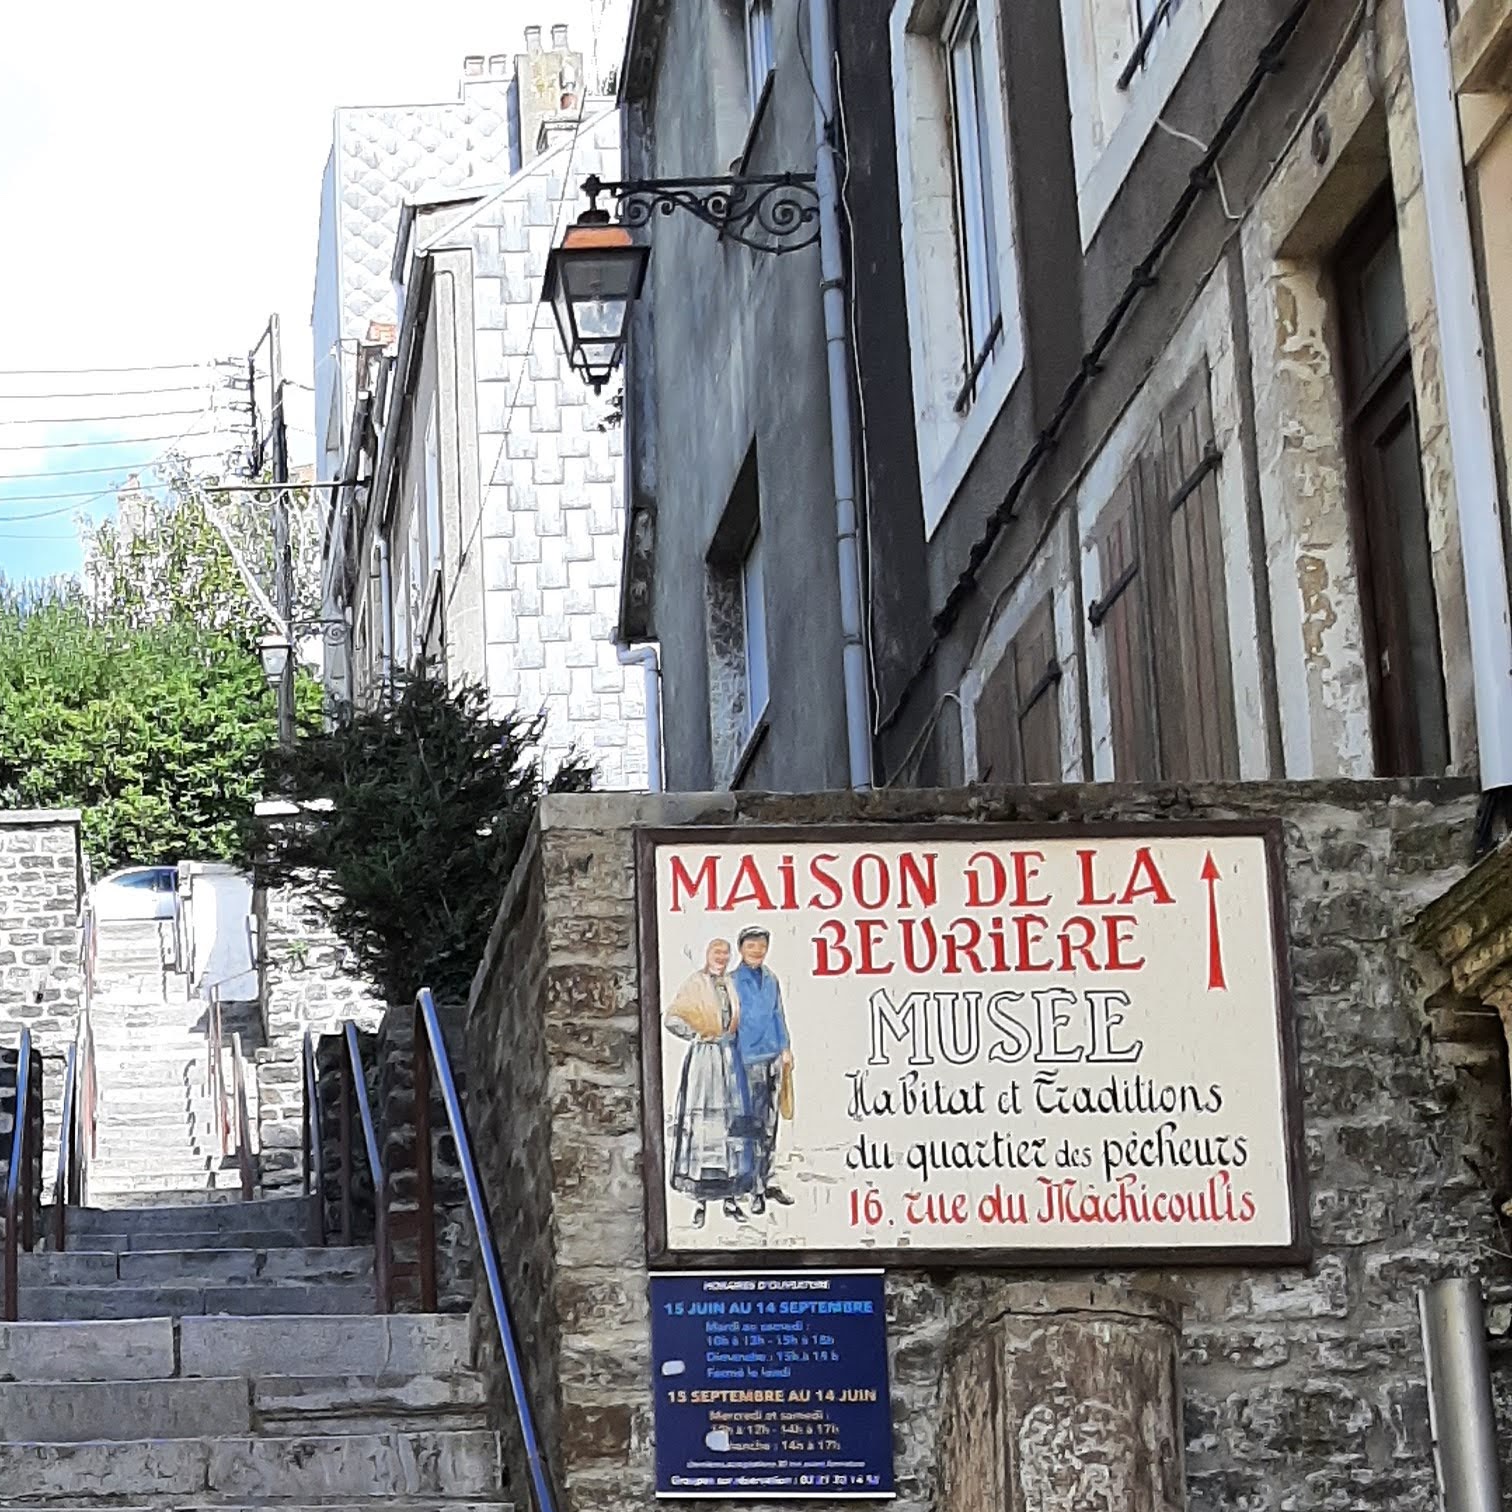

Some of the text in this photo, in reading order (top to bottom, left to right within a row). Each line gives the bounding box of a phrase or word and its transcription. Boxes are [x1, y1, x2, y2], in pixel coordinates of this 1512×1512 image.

[963, 850, 1053, 907] DE
[1076, 847, 1177, 904] LA
[845, 1068, 1223, 1117] Habitat et Traditions
[846, 1133, 894, 1169] du
[906, 1131, 1047, 1182] quartier
[1055, 1139, 1092, 1168] des
[903, 1191, 969, 1224] rue
[978, 1183, 1029, 1224] du
[664, 1300, 874, 1315] 15 JUIN AU 14 SEPTEMBRE
[668, 1388, 877, 1403] 15 SEPTEMBRE AU 14 JUIN
